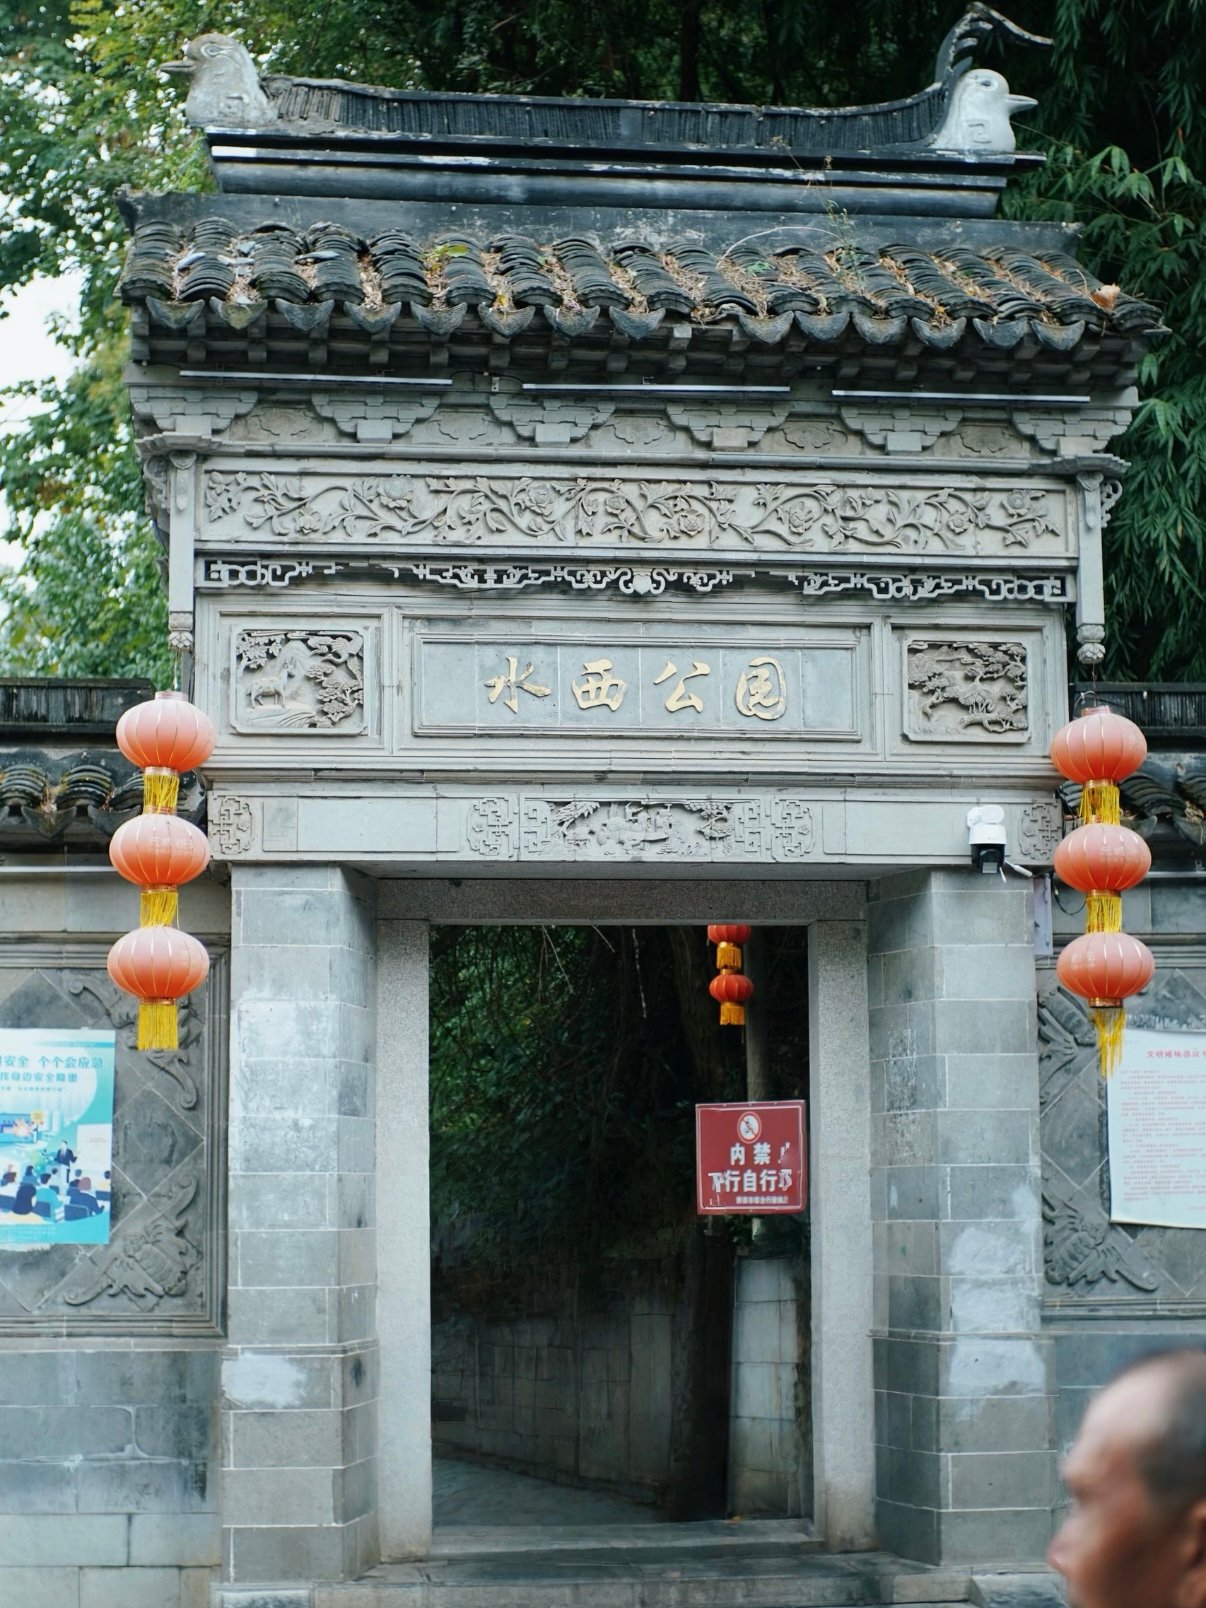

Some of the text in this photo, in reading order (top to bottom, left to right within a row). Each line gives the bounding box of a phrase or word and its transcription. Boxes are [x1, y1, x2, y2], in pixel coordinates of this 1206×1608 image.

[484, 656, 788, 720] 水西公园
[0, 1055, 29, 1068] 安全
